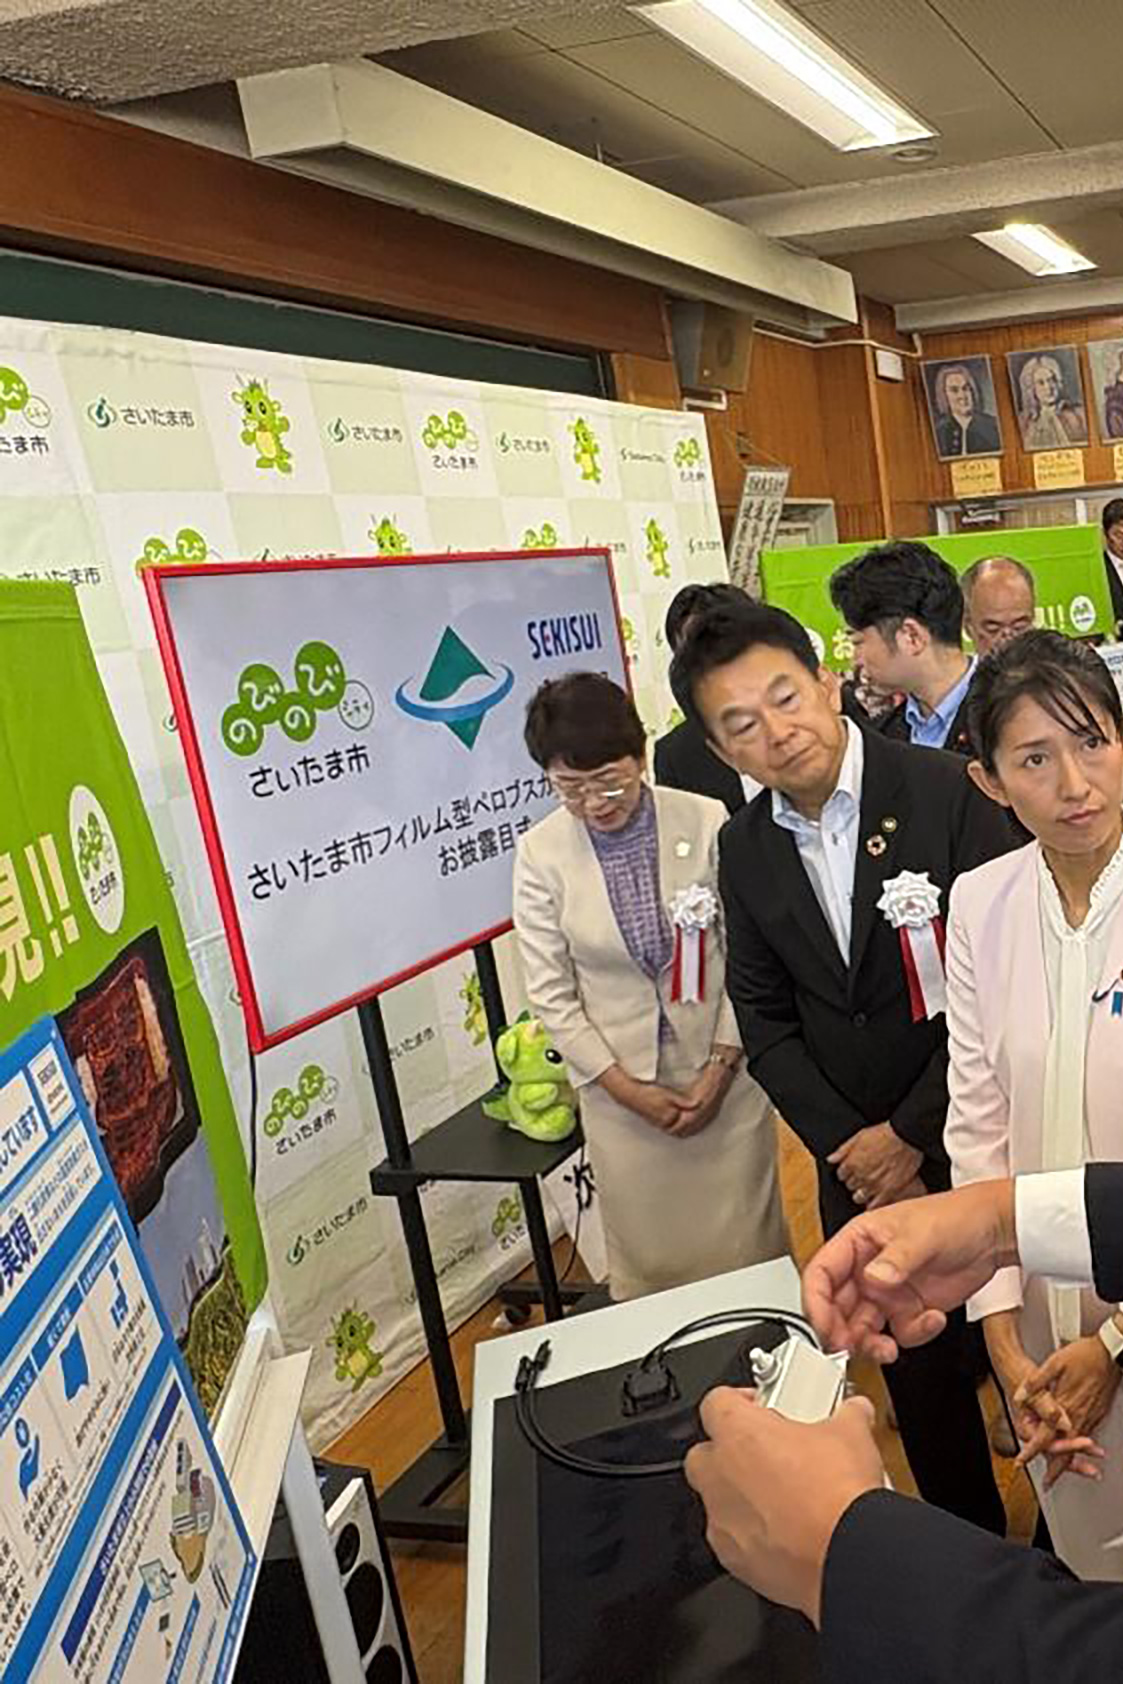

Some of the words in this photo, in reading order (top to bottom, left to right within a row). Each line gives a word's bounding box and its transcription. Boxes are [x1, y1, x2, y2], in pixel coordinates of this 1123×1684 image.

[120, 407, 195, 428] さいたま市
[527, 613, 602, 659] SEKISUI
[249, 743, 370, 798] さいたま市
